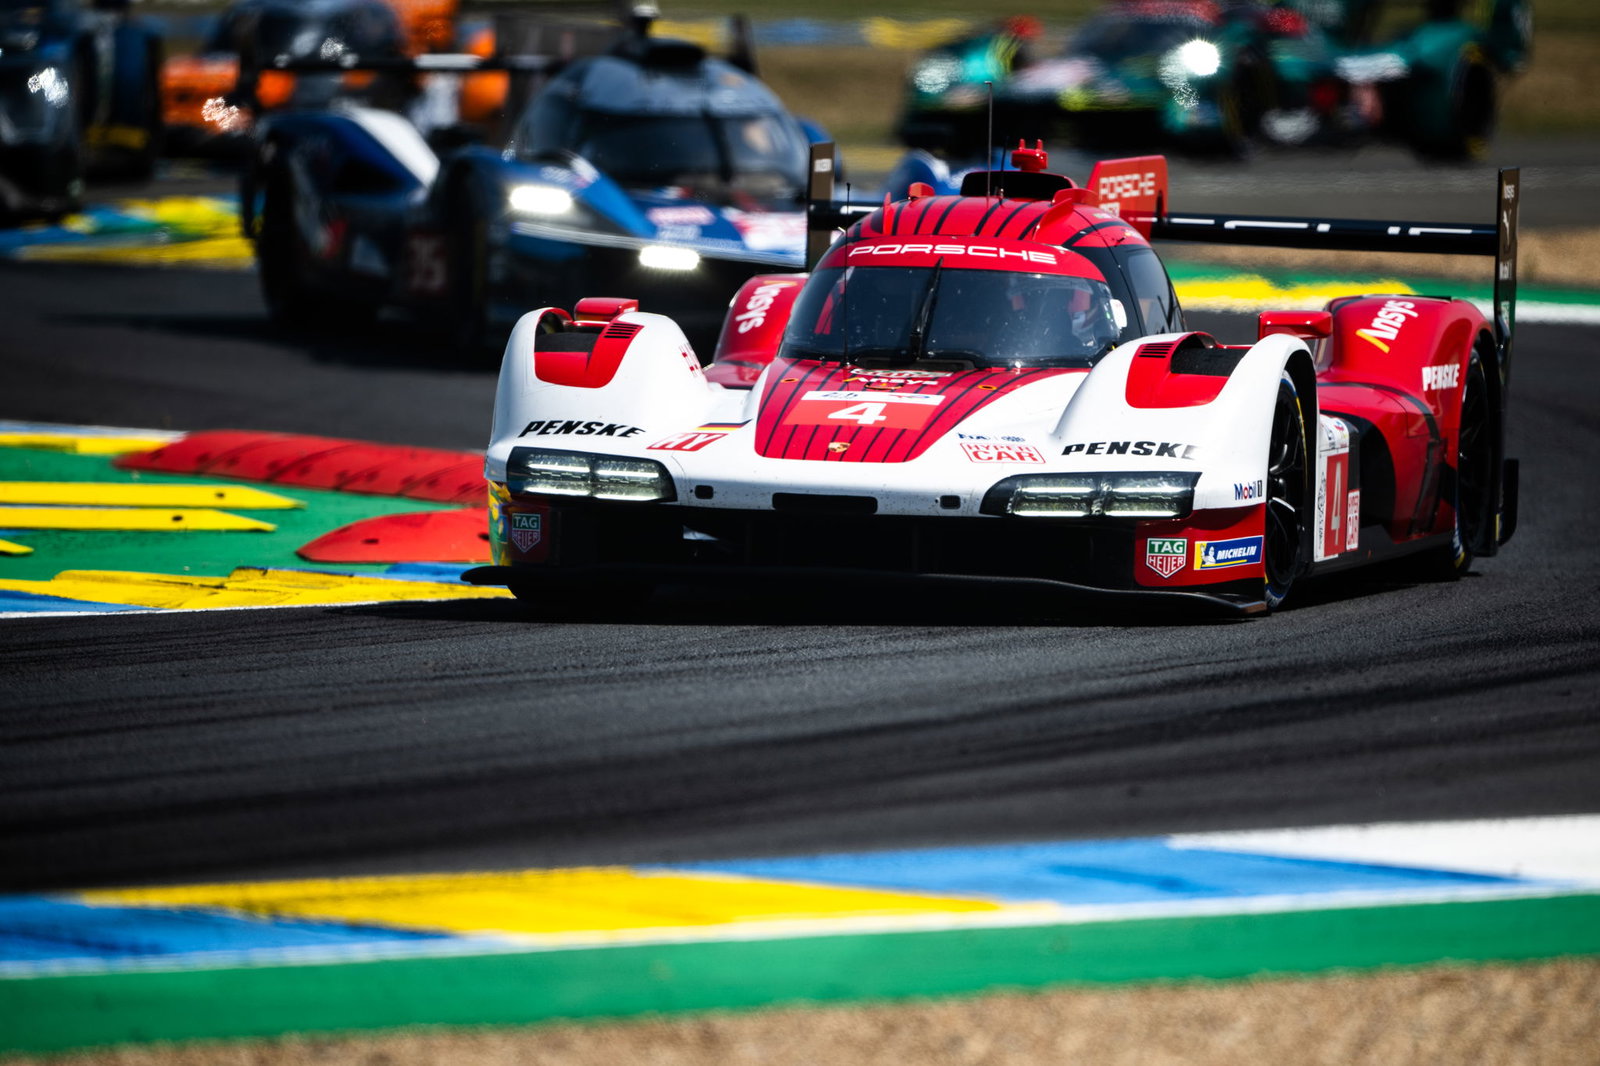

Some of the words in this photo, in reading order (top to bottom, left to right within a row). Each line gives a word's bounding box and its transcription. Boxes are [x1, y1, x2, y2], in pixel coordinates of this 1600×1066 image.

[848, 244, 1058, 265] PORSCHE
[1355, 300, 1419, 354] Ansys
[1422, 364, 1460, 392] PENSKE
[827, 402, 888, 425] 4
[517, 420, 647, 439] PENSKE
[971, 450, 1040, 462] CAR
[1233, 481, 1257, 501] Mobil
[1330, 461, 1342, 547] 4
[514, 516, 538, 529] TAG
[513, 531, 539, 549] HEUER
[1151, 541, 1184, 554] TAG
[1216, 546, 1258, 561] MICHELIN
[1148, 555, 1184, 575] HEUER
